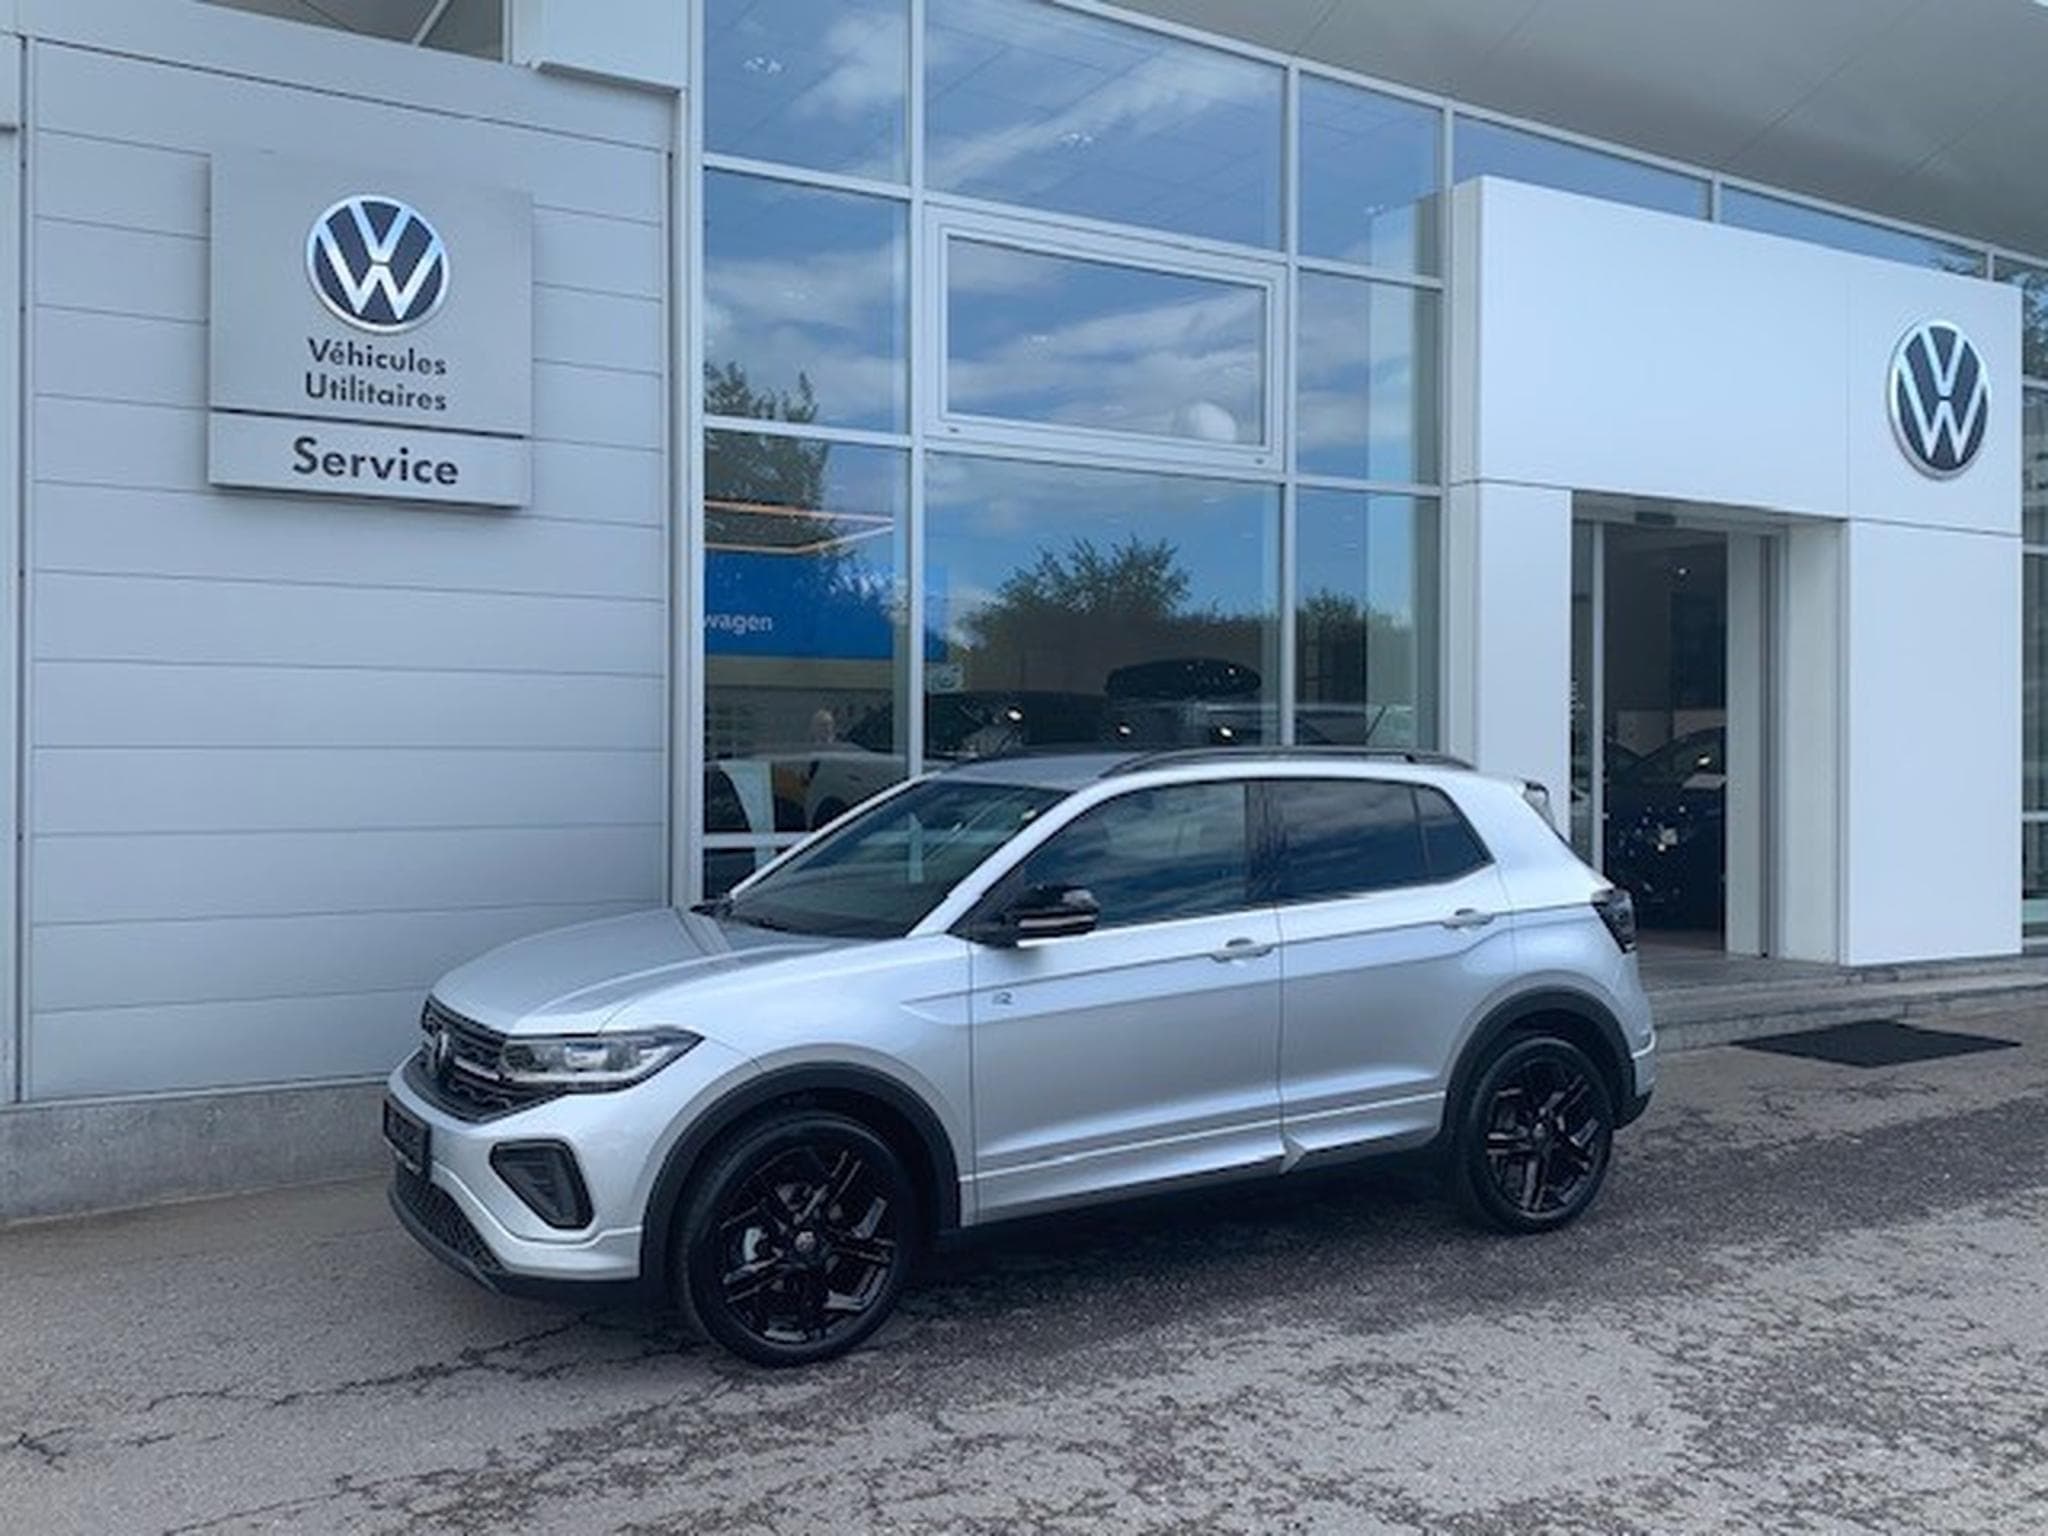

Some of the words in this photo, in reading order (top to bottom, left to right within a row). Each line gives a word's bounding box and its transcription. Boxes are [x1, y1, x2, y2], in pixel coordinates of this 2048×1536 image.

[307, 195, 449, 331] VW
[308, 338, 446, 375] Véhicules
[305, 372, 446, 410] Utilitaires
[1888, 321, 1991, 480] VW
[293, 437, 459, 485] Service
